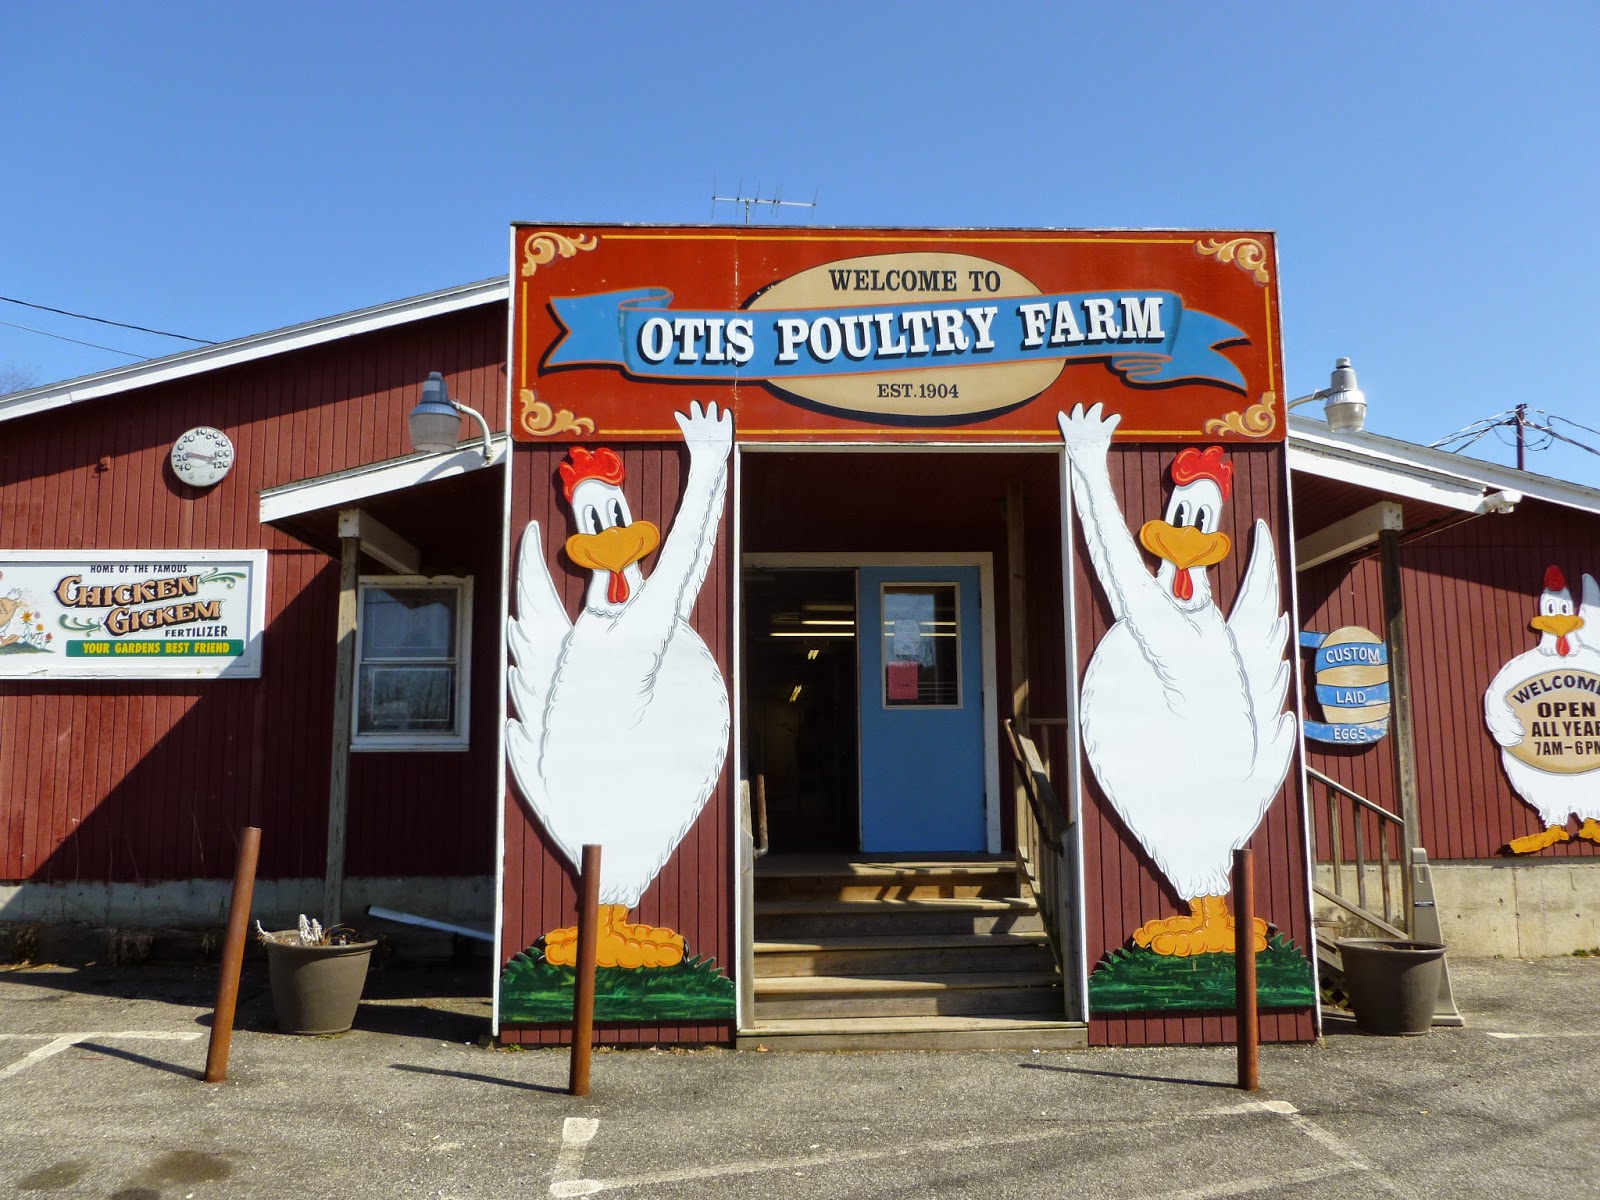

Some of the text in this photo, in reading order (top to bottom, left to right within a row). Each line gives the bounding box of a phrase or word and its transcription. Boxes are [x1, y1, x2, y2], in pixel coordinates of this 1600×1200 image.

[828, 268, 1001, 292] WELCOME TO
[638, 297, 1166, 366] OTIS POULTRY FARM
[182, 435, 195, 443] 20
[206, 431, 219, 440] 60
[215, 440, 227, 448] 80
[214, 450, 230, 458] 100
[213, 460, 229, 469] 120
[90, 564, 188, 573] HOME OF THE FAMOUS
[53, 574, 201, 608] CHICKEN
[103, 600, 222, 636] GICKEM
[165, 625, 228, 637] FERTILIZER
[83, 642, 230, 654] YOUR GARDENS BEST FRIEND
[1325, 647, 1380, 664] CUSTOM
[1336, 690, 1366, 704] LAID
[1537, 701, 1596, 718] OPEN
[1333, 727, 1367, 740] EGGS
[1531, 721, 1559, 737] ALL
